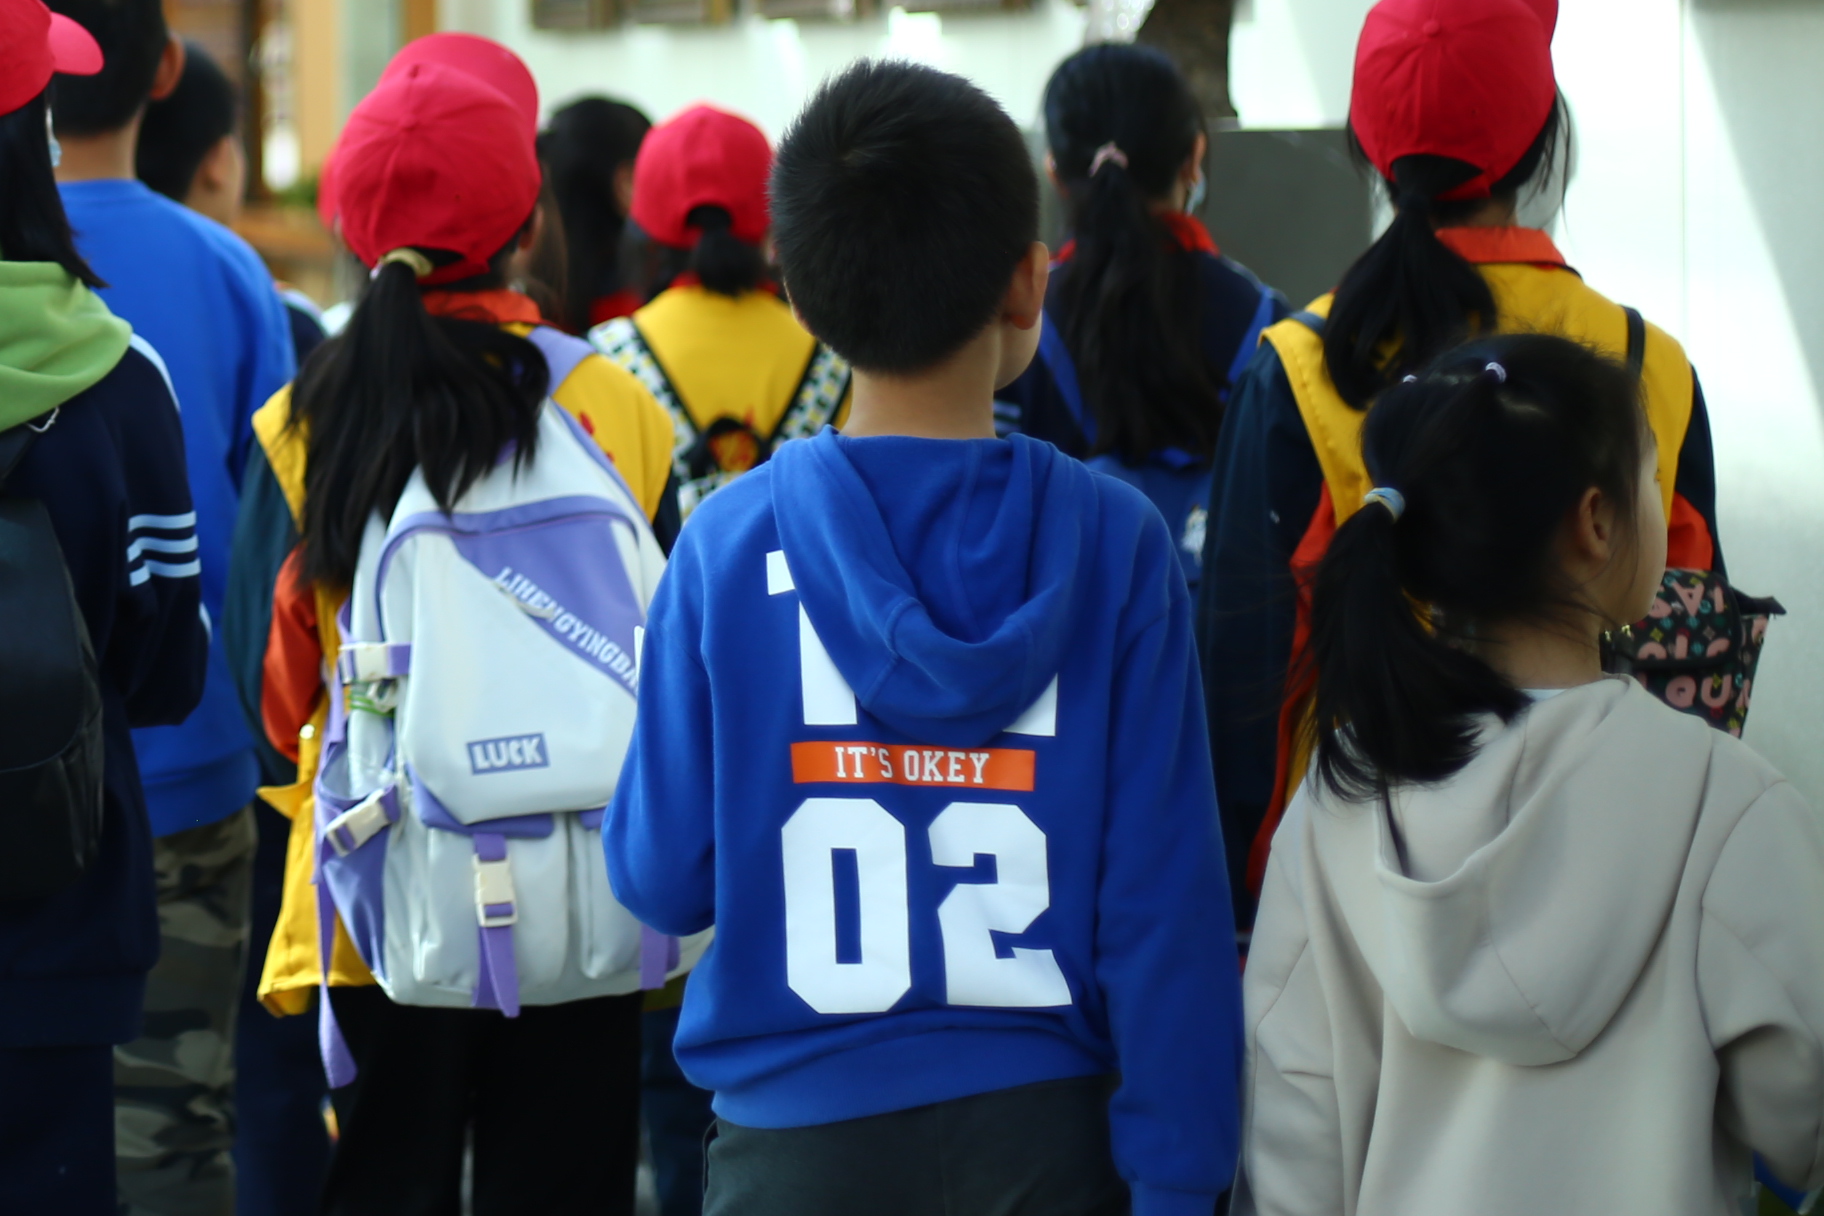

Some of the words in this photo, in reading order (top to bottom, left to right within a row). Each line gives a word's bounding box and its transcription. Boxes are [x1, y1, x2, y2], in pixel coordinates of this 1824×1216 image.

[473, 737, 543, 769] LUCK
[834, 746, 893, 779] IT'S
[903, 750, 990, 784] OKEY
[781, 797, 1073, 1015] 02
